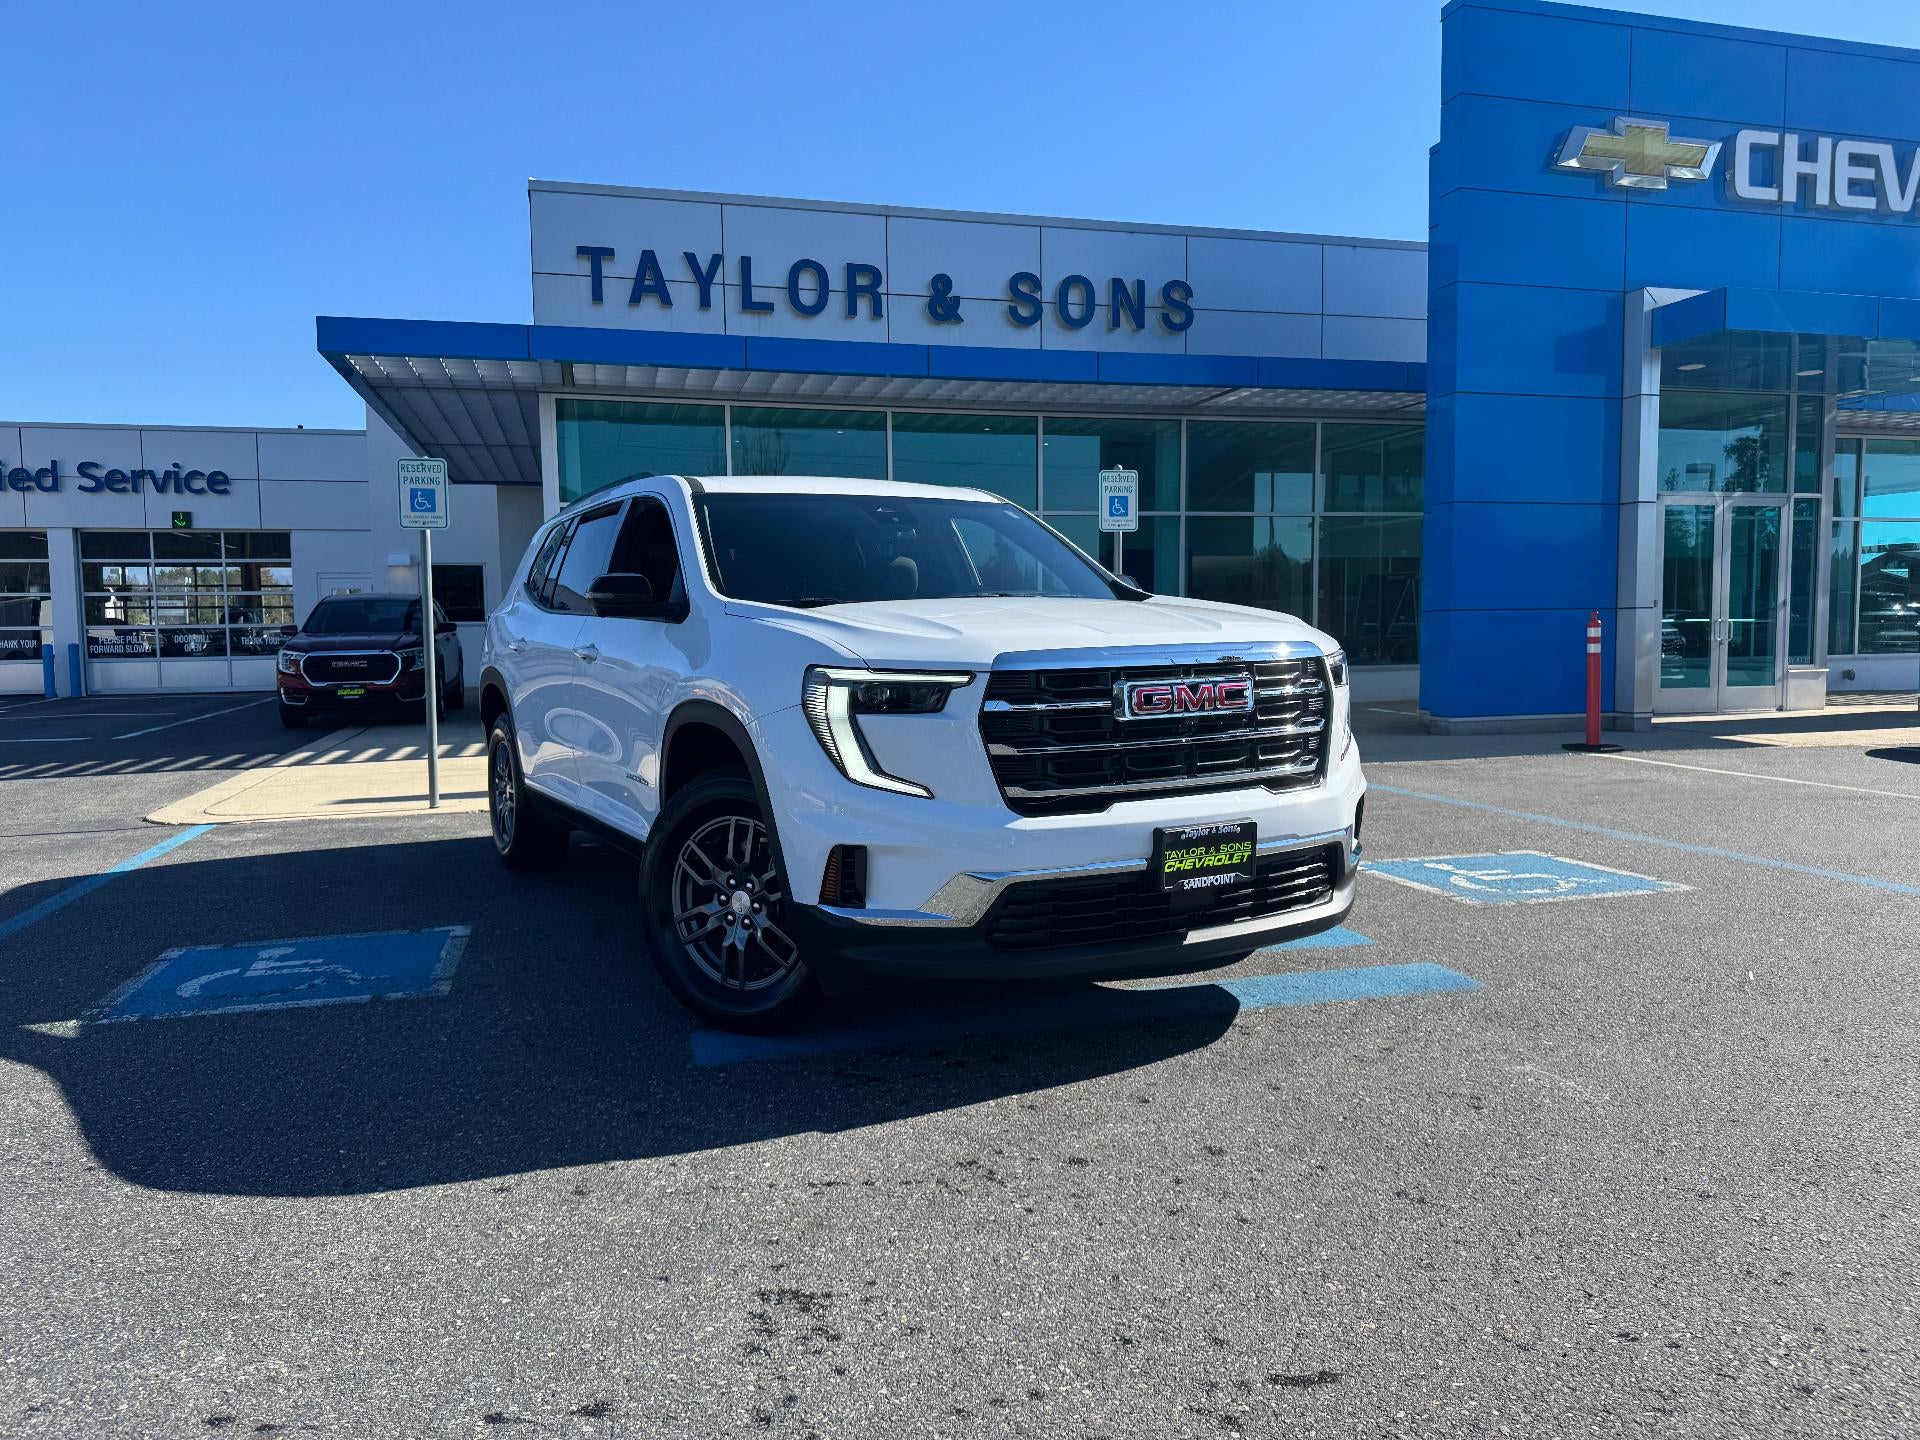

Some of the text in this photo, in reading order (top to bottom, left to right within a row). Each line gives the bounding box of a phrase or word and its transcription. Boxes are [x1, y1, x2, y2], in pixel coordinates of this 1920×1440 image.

[1734, 129, 1920, 213] CHEV
[576, 245, 1195, 333] TAYLOR & SONS
[400, 463, 442, 473] RESERVED
[0, 459, 230, 494] ed Service
[403, 476, 441, 485] PARKING
[1102, 475, 1135, 483] RESERVED
[1104, 485, 1133, 494] PARKING
[20, 639, 37, 648] YOU!
[99, 635, 144, 644] PLEASE PULL
[241, 636, 280, 645] THANK YOU!
[90, 645, 152, 654] FORWARD SLOWLY
[184, 643, 202, 652] OPEN
[1132, 682, 1249, 714] GMC
[1184, 826, 1210, 839] Taylor
[1218, 825, 1238, 834] Sons
[1165, 841, 1251, 860] TAYLOR & SONS
[1164, 852, 1251, 873] CHEVROLET
[1183, 873, 1235, 890] SANDPOINT
